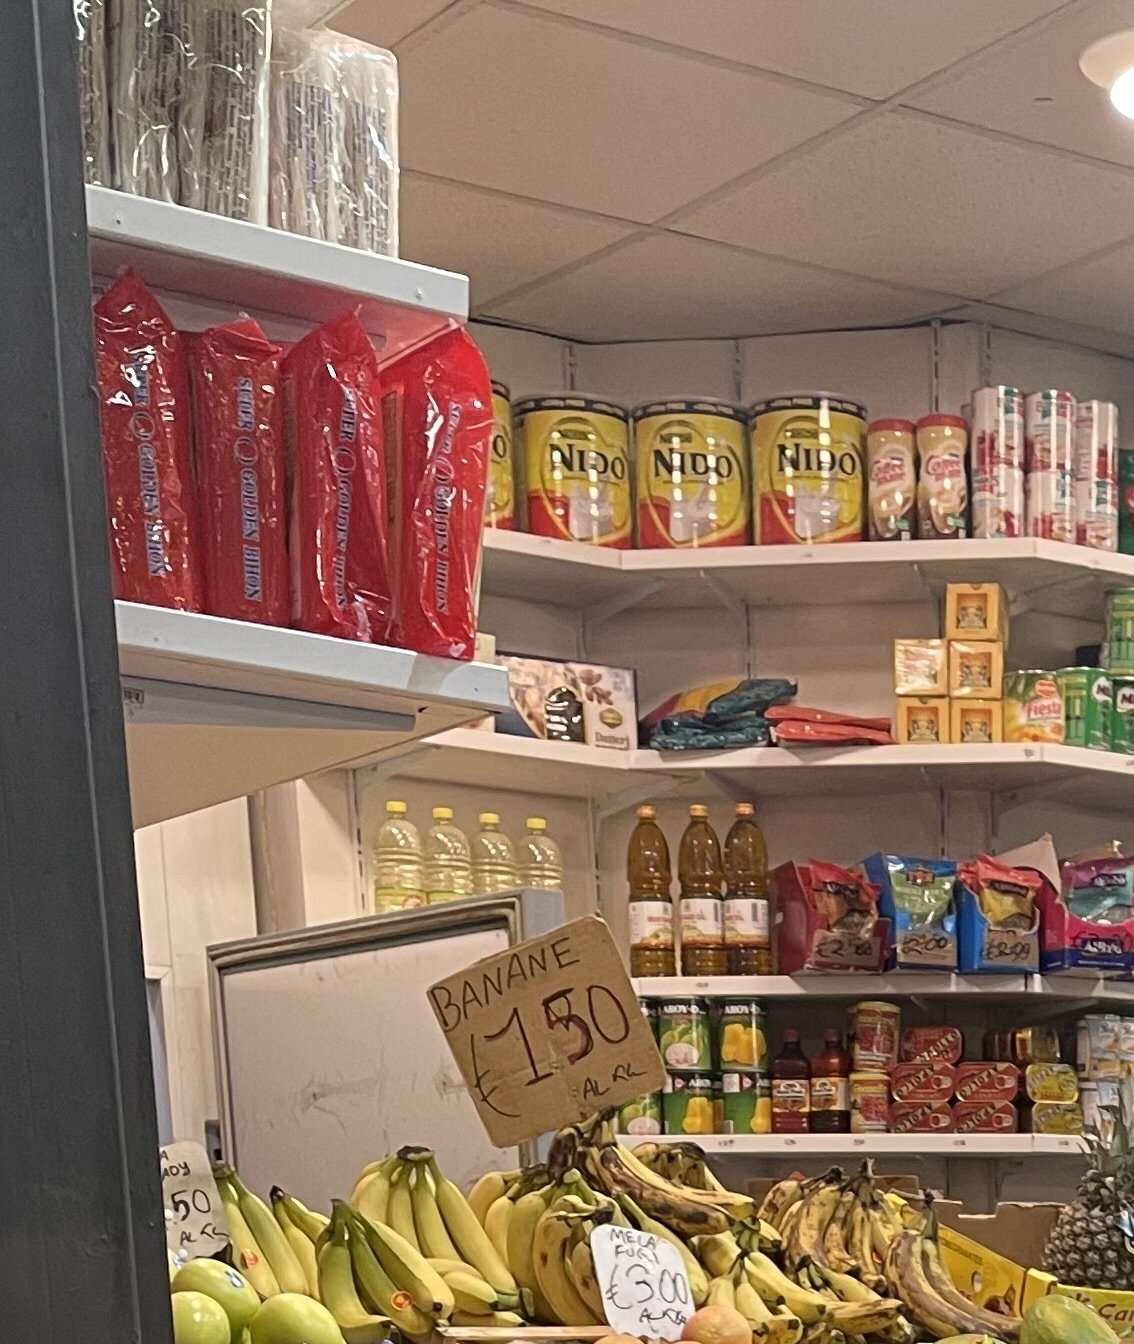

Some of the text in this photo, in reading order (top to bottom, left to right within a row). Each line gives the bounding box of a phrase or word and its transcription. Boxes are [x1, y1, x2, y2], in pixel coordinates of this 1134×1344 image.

[549, 443, 626, 481] NIDO
[653, 449, 733, 478] NIDO
[777, 443, 856, 476] NIDO
[241, 468, 260, 542] GOLDEN
[243, 548, 262, 602] BIHON
[430, 937, 580, 1033] BANANE
[609, 1228, 656, 1250] MELA
